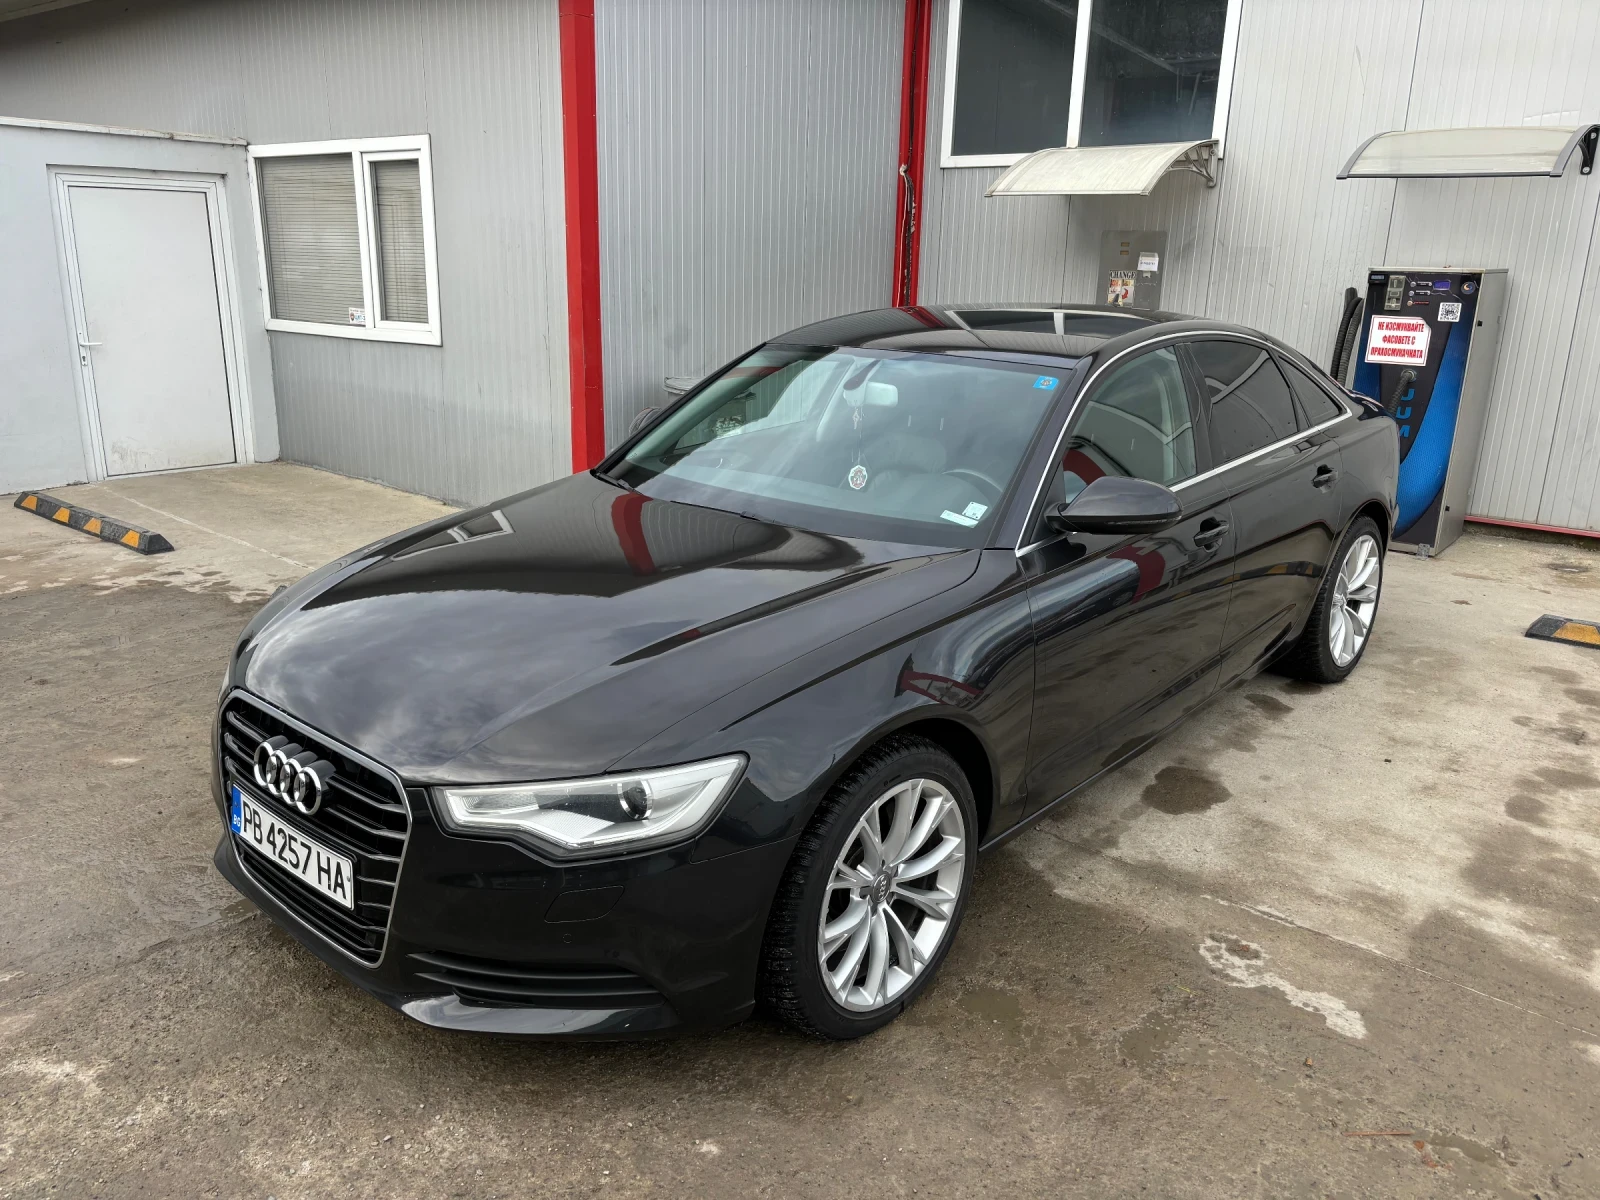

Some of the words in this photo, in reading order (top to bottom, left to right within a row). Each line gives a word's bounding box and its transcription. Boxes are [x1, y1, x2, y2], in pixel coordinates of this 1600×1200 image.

[1110, 271, 1136, 279] CHANGE
[1378, 321, 1385, 331] НЕ
[1411, 336, 1416, 345] С
[233, 814, 241, 827] BG
[243, 799, 263, 844] PB
[266, 821, 312, 875] 4257
[316, 850, 347, 900] HA
